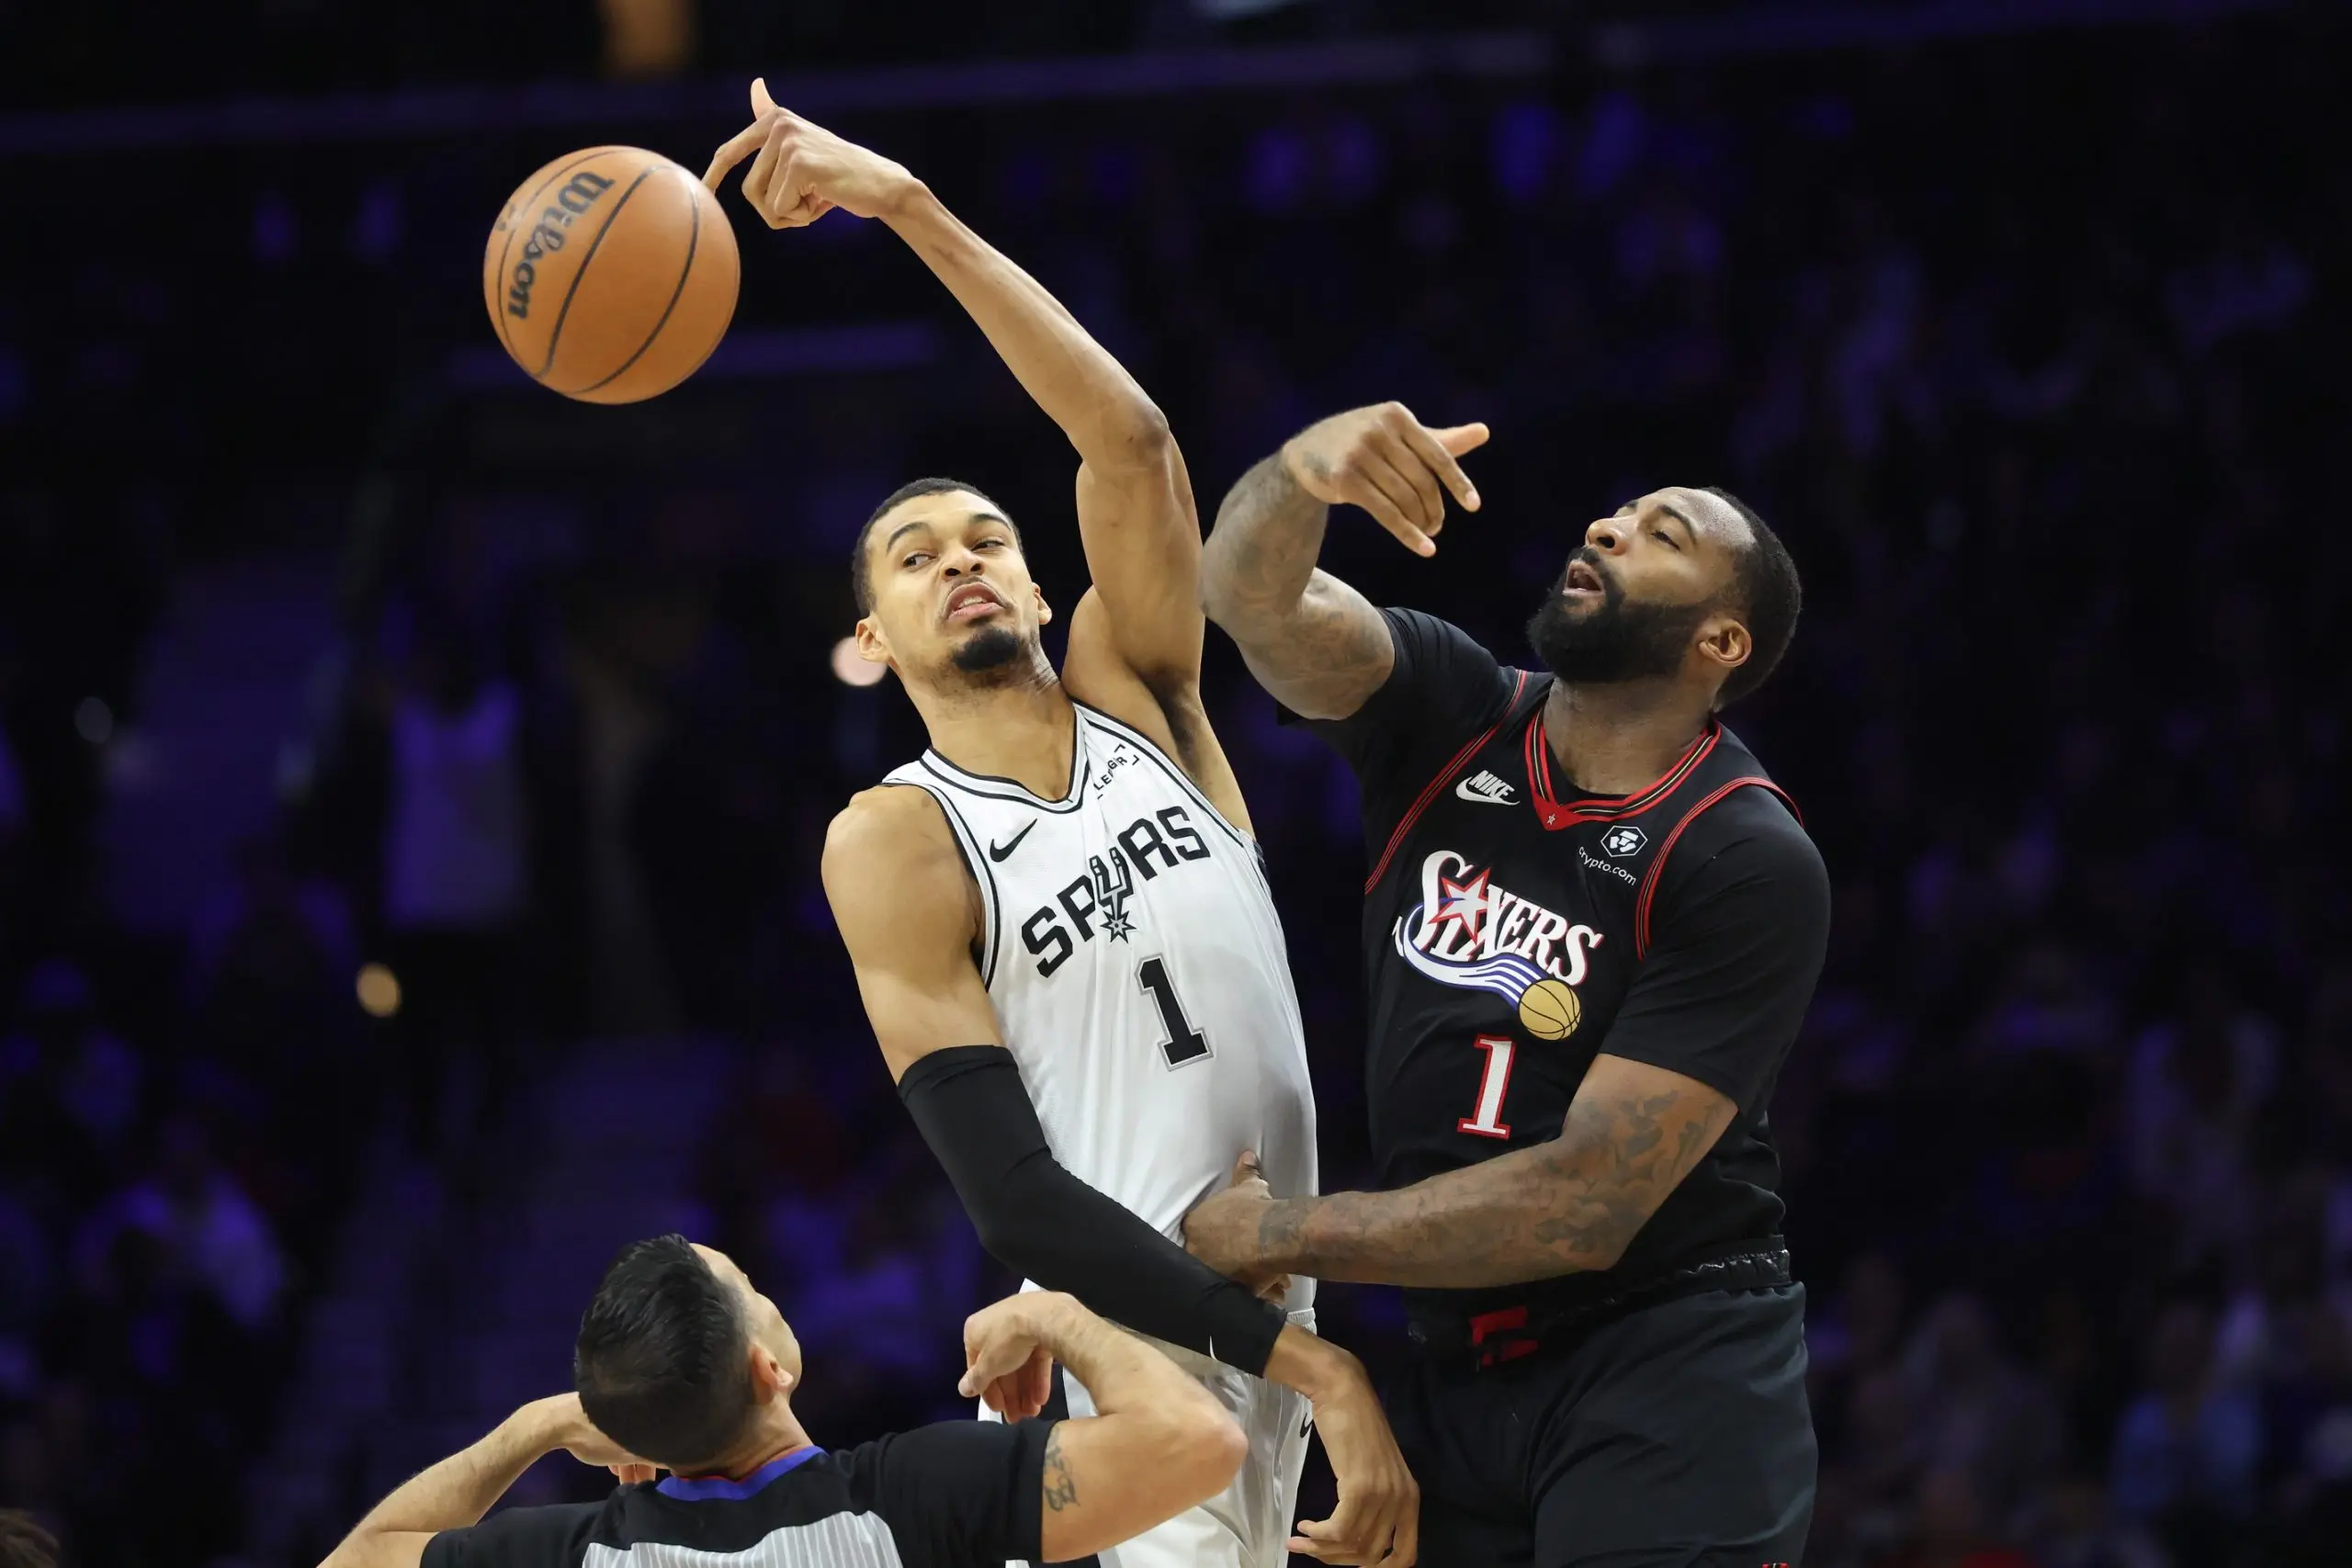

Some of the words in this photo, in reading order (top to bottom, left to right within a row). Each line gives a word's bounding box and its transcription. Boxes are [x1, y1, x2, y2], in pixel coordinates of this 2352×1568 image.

[508, 172, 615, 319] Wilson
[1468, 770, 1515, 799] NIKE
[1022, 807, 1211, 978] SPURS
[1136, 953, 1214, 1072] 1
[1458, 1033, 1516, 1140] 1
